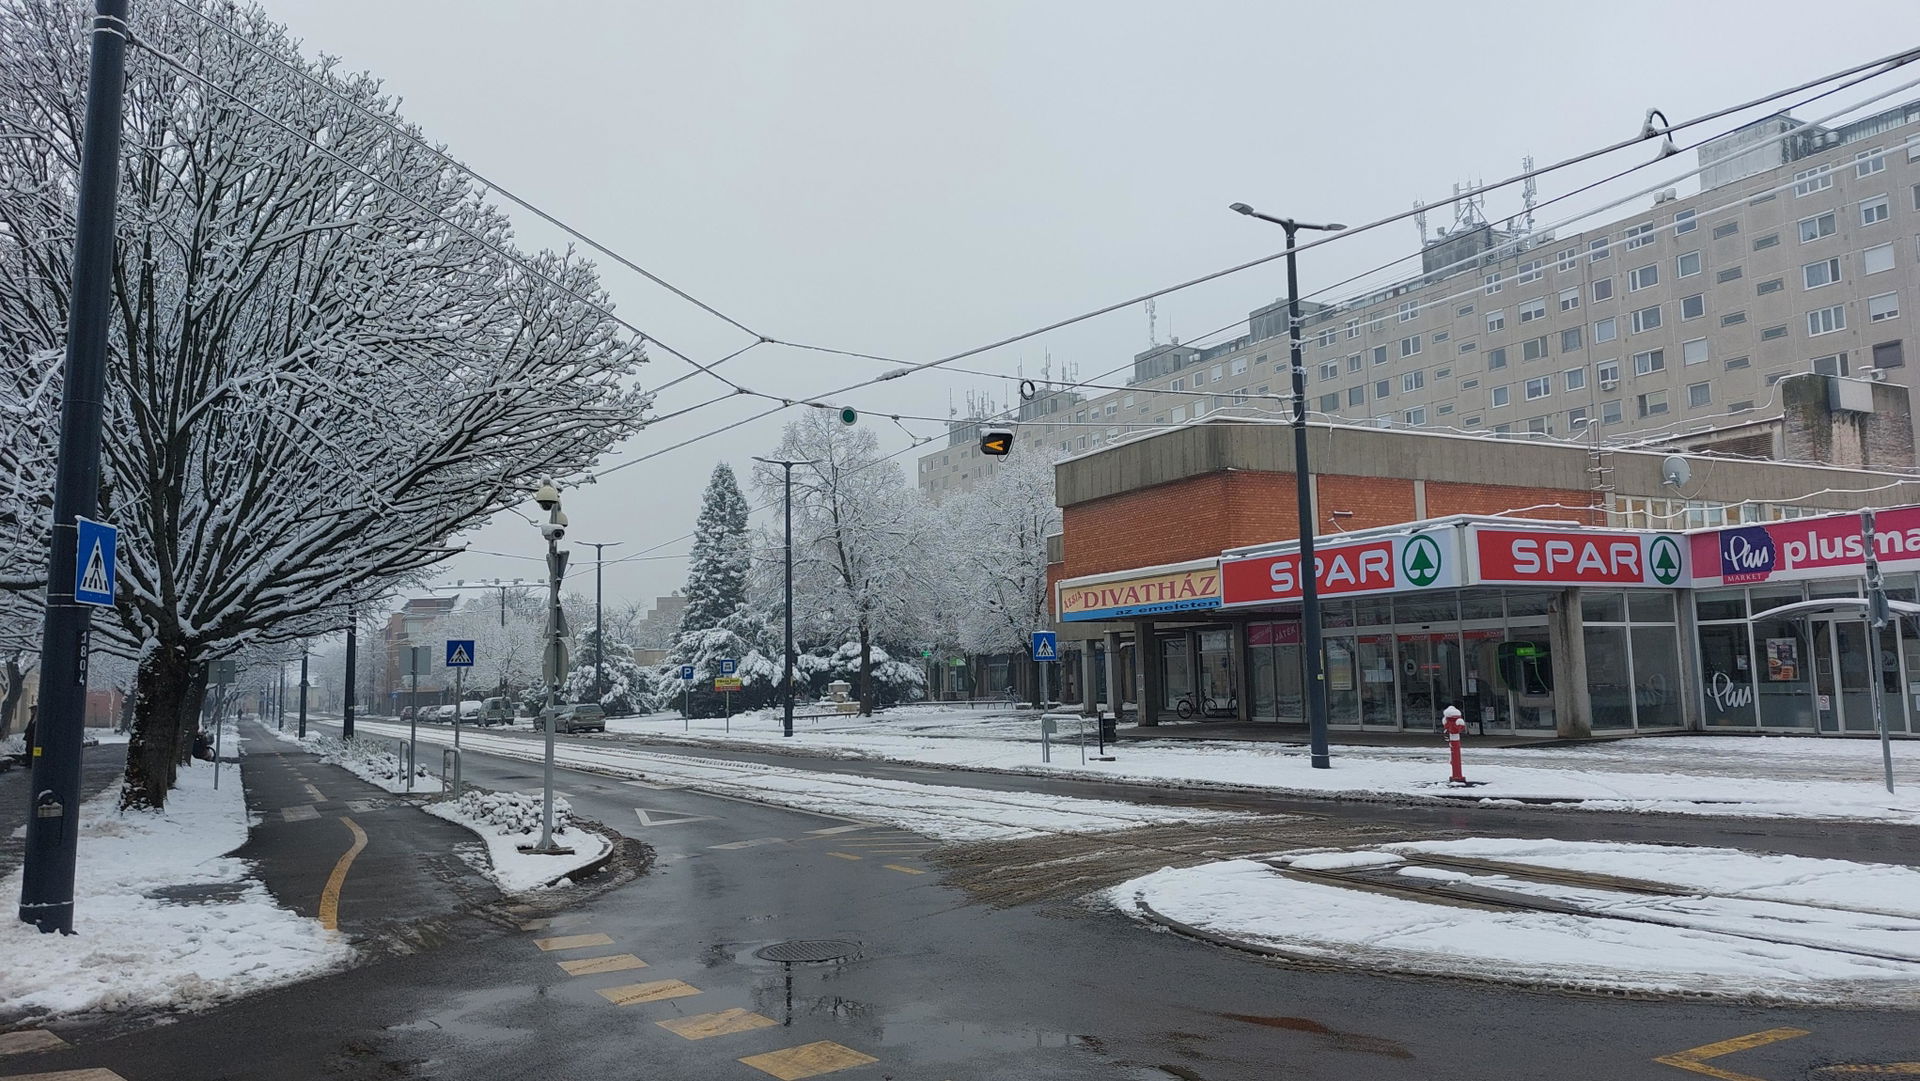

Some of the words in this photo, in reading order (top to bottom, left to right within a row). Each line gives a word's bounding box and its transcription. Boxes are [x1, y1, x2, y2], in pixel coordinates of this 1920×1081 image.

[1511, 538, 1640, 575] SPAR
[1724, 535, 1769, 571] Plus
[1083, 572, 1218, 609] DIVATHÁZ
[1727, 573, 1762, 582] MARKET
[1115, 608, 1132, 616] az
[1138, 600, 1220, 614] emeleten
[78, 631, 88, 687] 1804
[684, 668, 692, 678] P
[1706, 672, 1752, 713] Plus
